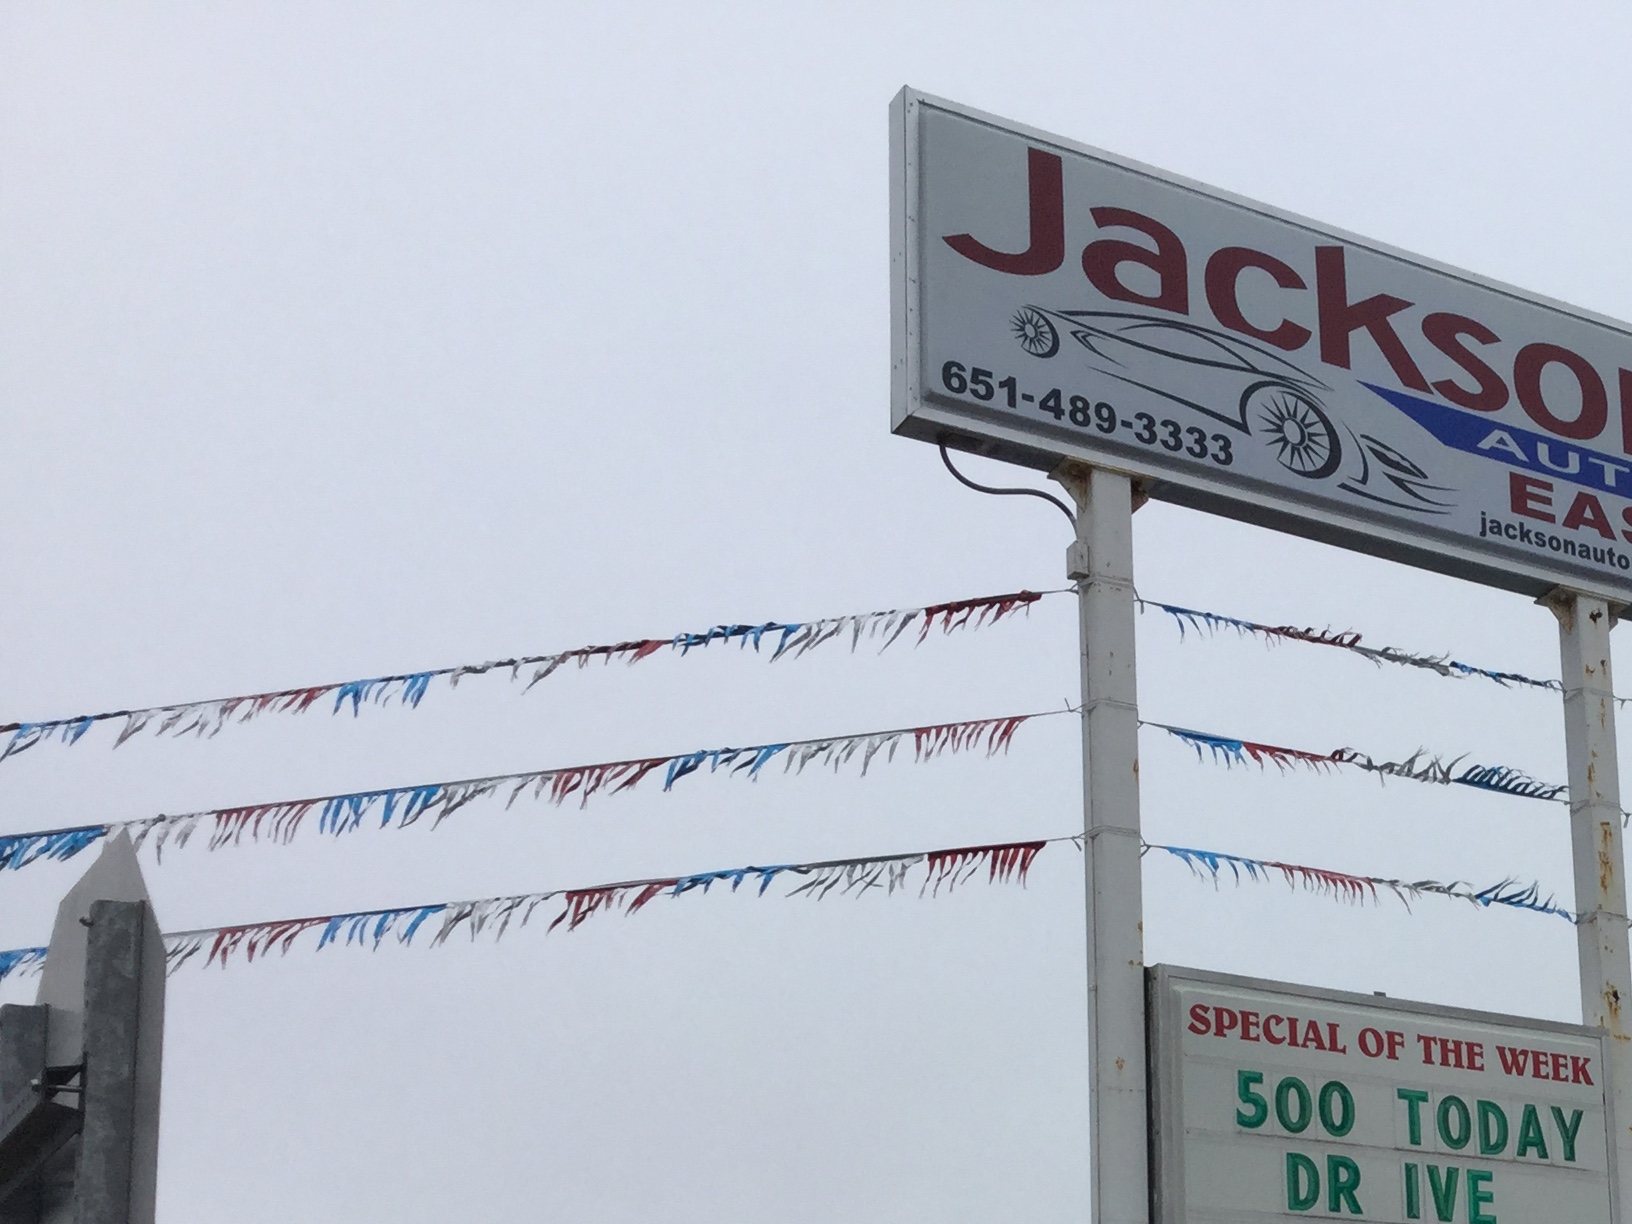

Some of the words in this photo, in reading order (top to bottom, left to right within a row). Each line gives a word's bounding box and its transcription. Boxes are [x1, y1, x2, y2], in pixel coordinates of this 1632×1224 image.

[941, 360, 1235, 467] 651-489-3333
[1187, 1003, 1347, 1055] SPECIAL
[1357, 1027, 1405, 1061] OF
[1417, 1034, 1485, 1072] THE
[1495, 1045, 1594, 1086] WEEK
[1235, 1069, 1355, 1138] 500
[1397, 1088, 1584, 1162] TODAY
